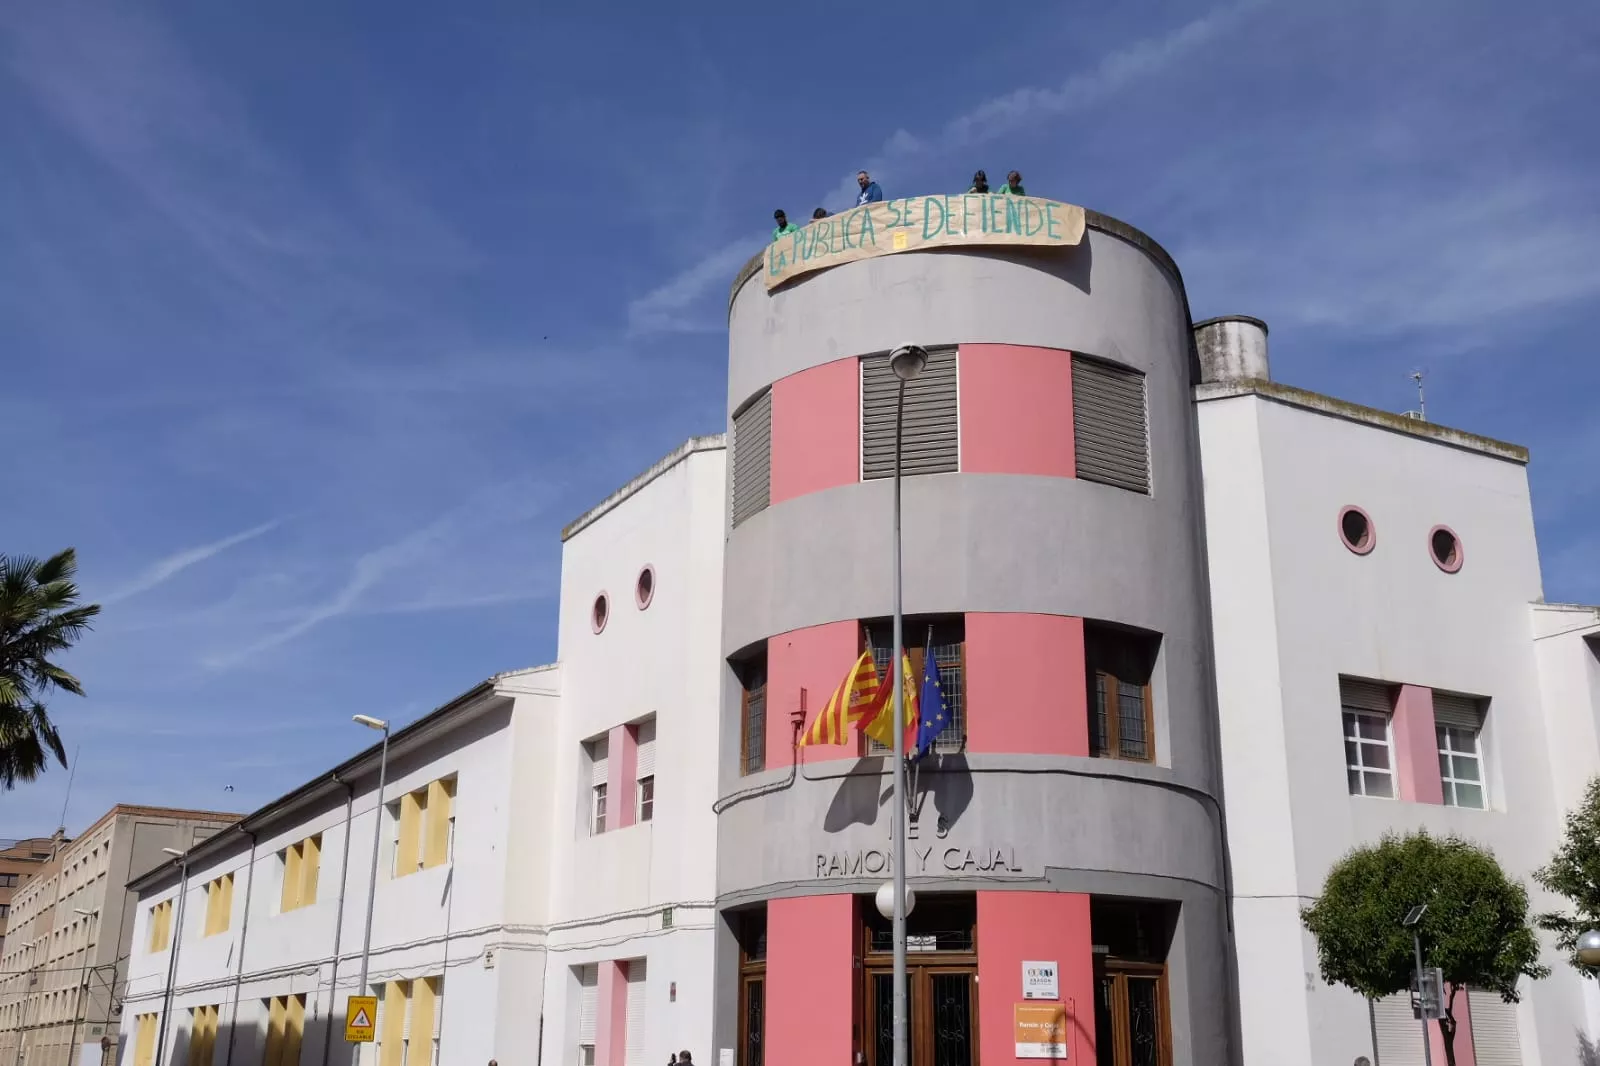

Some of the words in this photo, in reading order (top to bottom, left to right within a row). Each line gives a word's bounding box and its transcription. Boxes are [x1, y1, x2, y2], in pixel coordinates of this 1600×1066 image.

[770, 245, 787, 276] LA
[793, 208, 876, 264] PUBLICA
[884, 198, 918, 230] SE
[922, 194, 1063, 241] DEFIENDE
[913, 846, 932, 872] Y
[943, 847, 1023, 873] CAJAL
